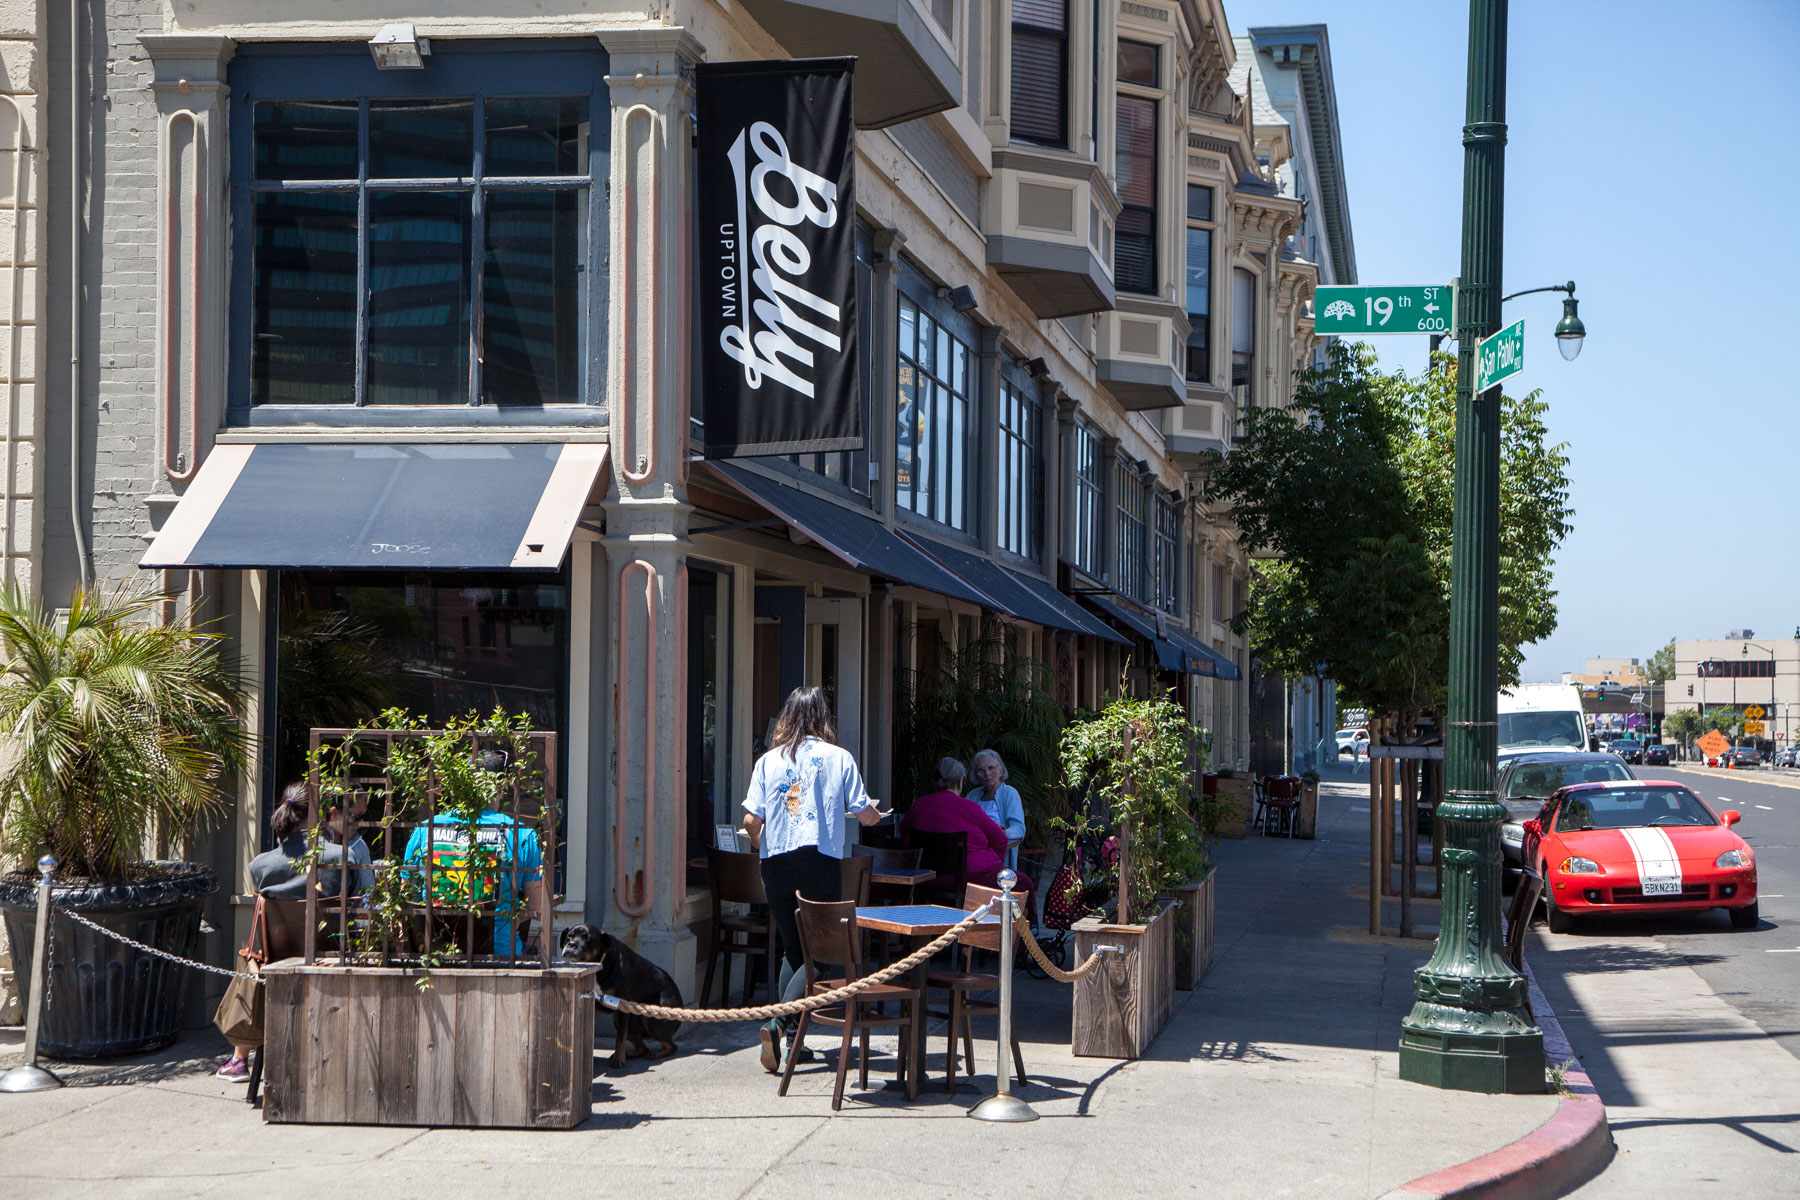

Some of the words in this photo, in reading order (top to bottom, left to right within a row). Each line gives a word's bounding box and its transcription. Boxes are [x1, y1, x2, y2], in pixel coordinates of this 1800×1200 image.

[719, 120, 841, 399] Belly
[719, 222, 736, 318] UPTOWN
[1364, 296, 1394, 326] 19
[1398, 295, 1412, 308] th
[1423, 287, 1440, 300] ST
[1417, 317, 1445, 331] 600
[1484, 346, 1496, 376] San
[1497, 335, 1515, 371] Pablo
[476, 830, 504, 844] BUILT
[1645, 883, 1680, 893] 5BKN231
